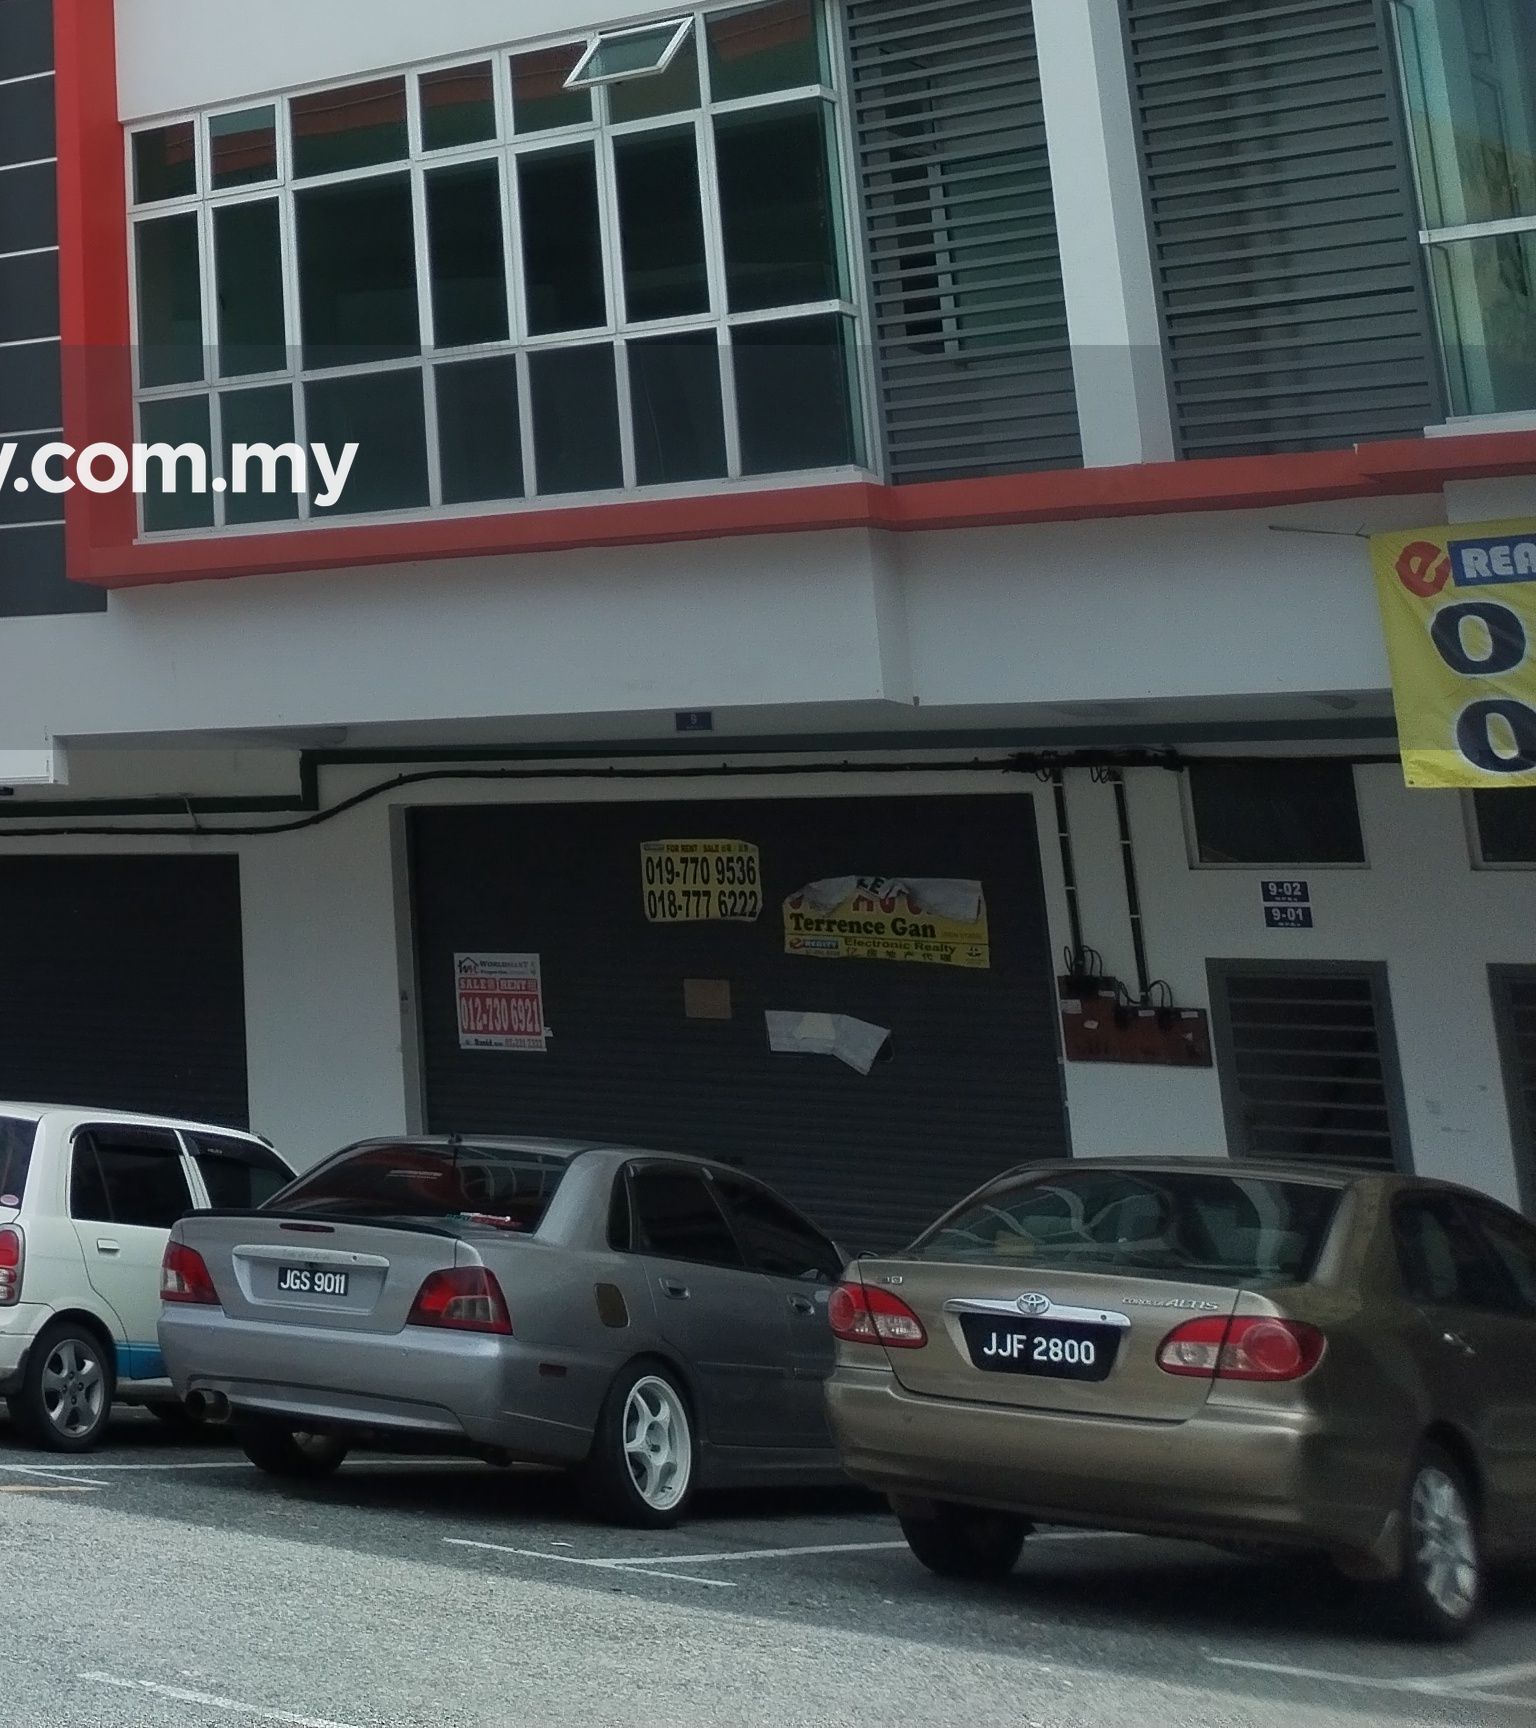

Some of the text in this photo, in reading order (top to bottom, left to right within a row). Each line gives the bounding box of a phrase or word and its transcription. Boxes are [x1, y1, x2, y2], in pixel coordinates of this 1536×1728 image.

[646, 856, 756, 885] 019-770 9536
[1268, 882, 1302, 895] 9-02
[648, 890, 712, 918] 018-777
[718, 890, 758, 918] 6222
[1271, 908, 1304, 921] 9-01
[789, 913, 886, 935] Terrence
[891, 917, 936, 938] Gan
[844, 937, 956, 955] Electronic Realty
[459, 979, 527, 990] SALE RENT
[461, 996, 541, 1033] 012-730 6921
[280, 1269, 346, 1294] JGS 9011
[1165, 1299, 1218, 1310] ALTIS
[983, 1331, 1097, 1367] JJF 2800
